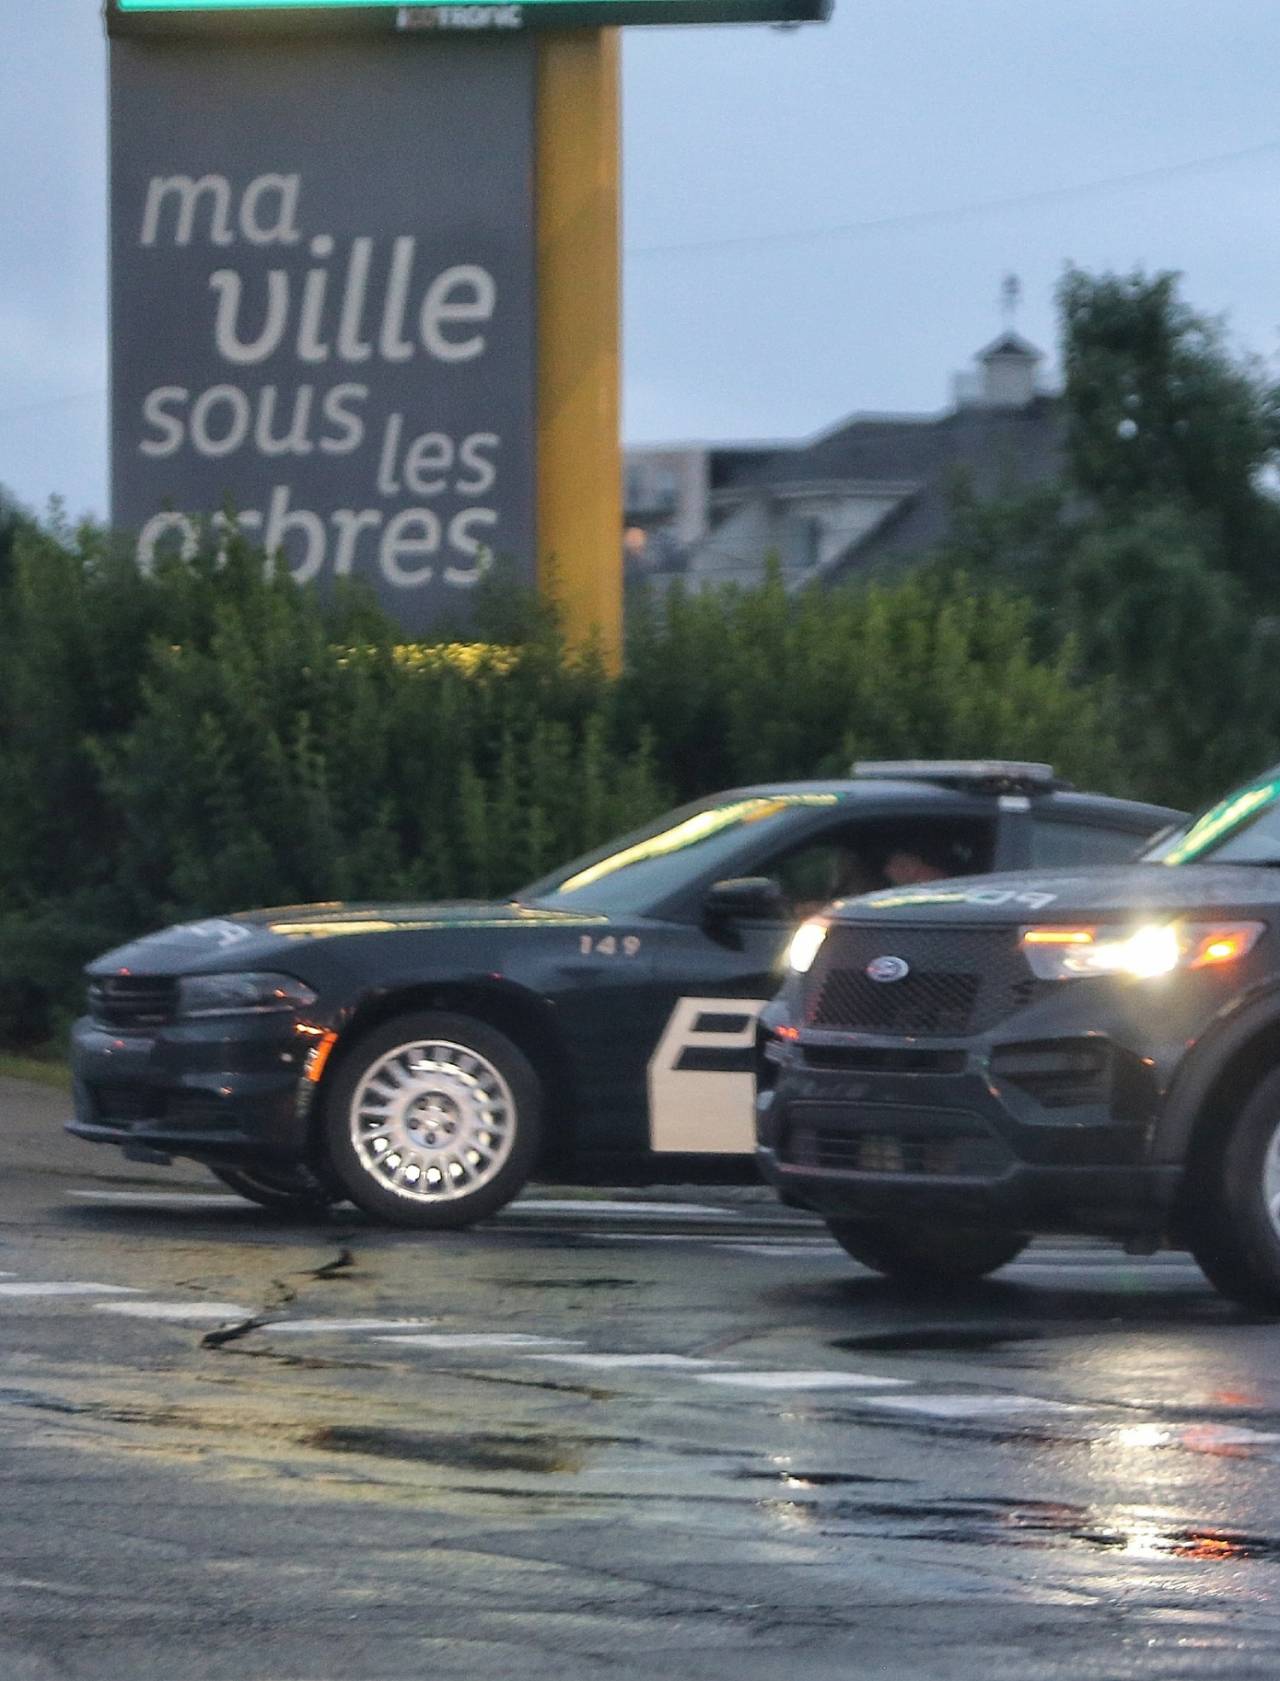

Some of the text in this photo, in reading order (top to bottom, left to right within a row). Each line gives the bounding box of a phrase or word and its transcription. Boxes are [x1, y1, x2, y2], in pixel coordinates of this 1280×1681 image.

[139, 172, 300, 247] ma
[209, 234, 498, 365] ville
[138, 382, 370, 458] sous
[377, 413, 499, 497] les
[578, 934, 641, 957] 149
